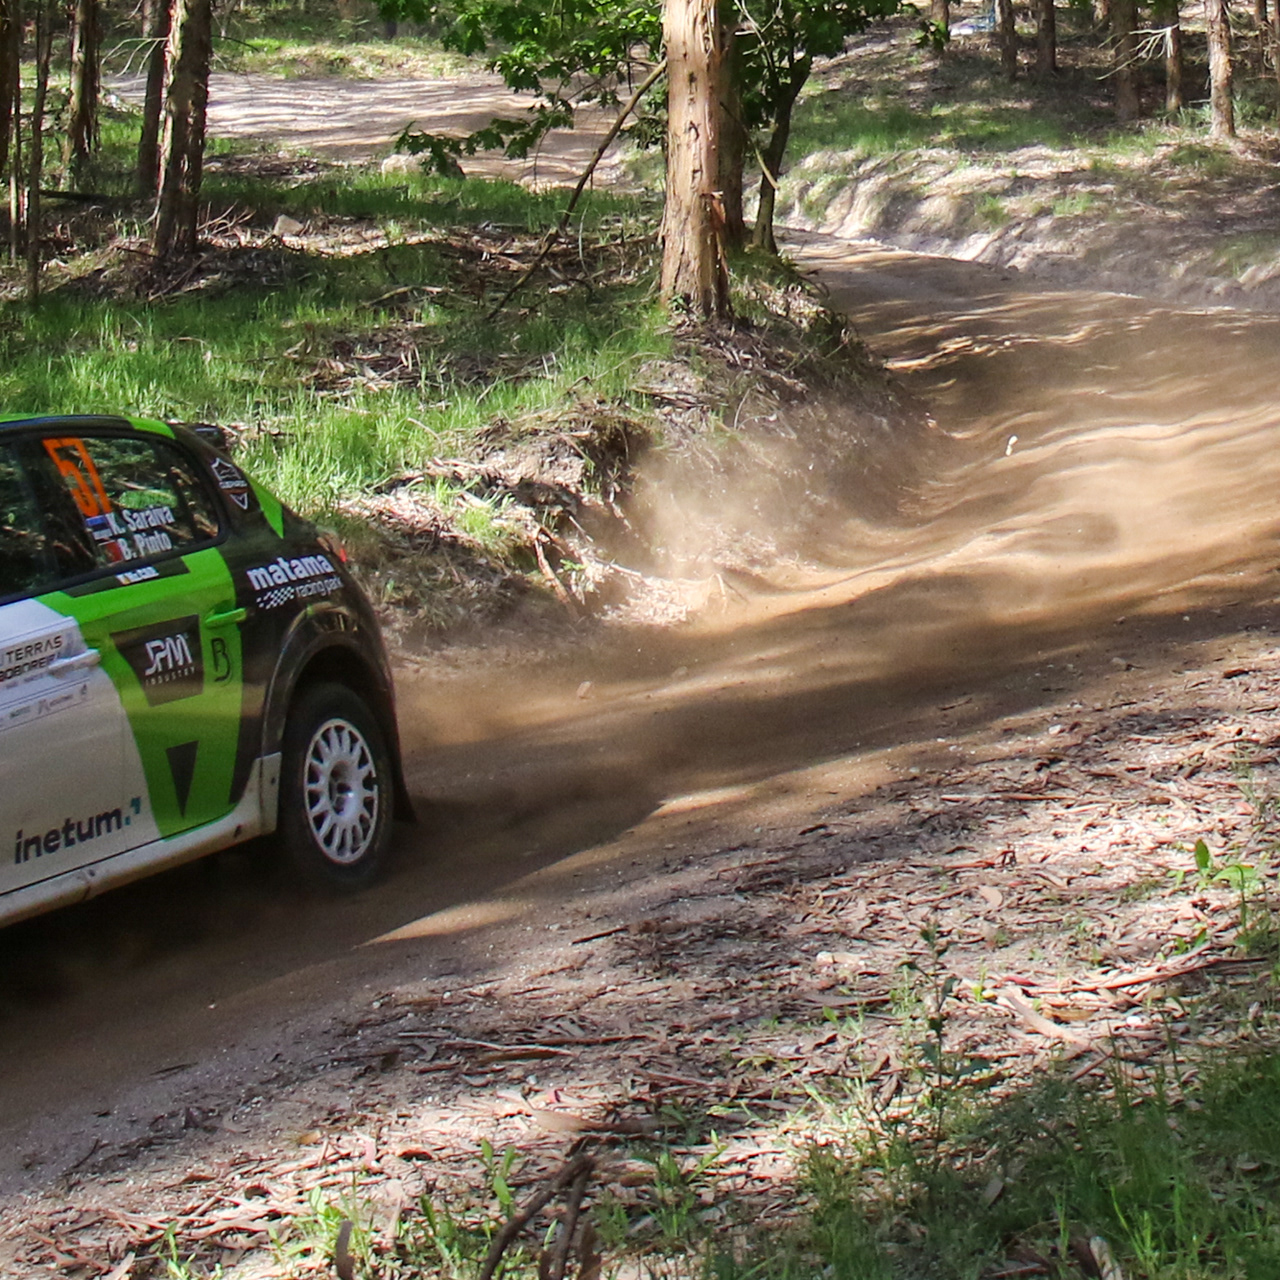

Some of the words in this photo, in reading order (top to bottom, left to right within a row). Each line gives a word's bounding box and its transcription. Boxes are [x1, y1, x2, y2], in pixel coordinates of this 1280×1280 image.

[42, 437, 113, 518] 57
[122, 505, 175, 531] Saraiva
[117, 537, 138, 561] B.
[133, 531, 173, 557] Pinto
[246, 554, 336, 591] matama
[295, 579, 327, 598] racing
[145, 666, 196, 686] INDUSTRY
